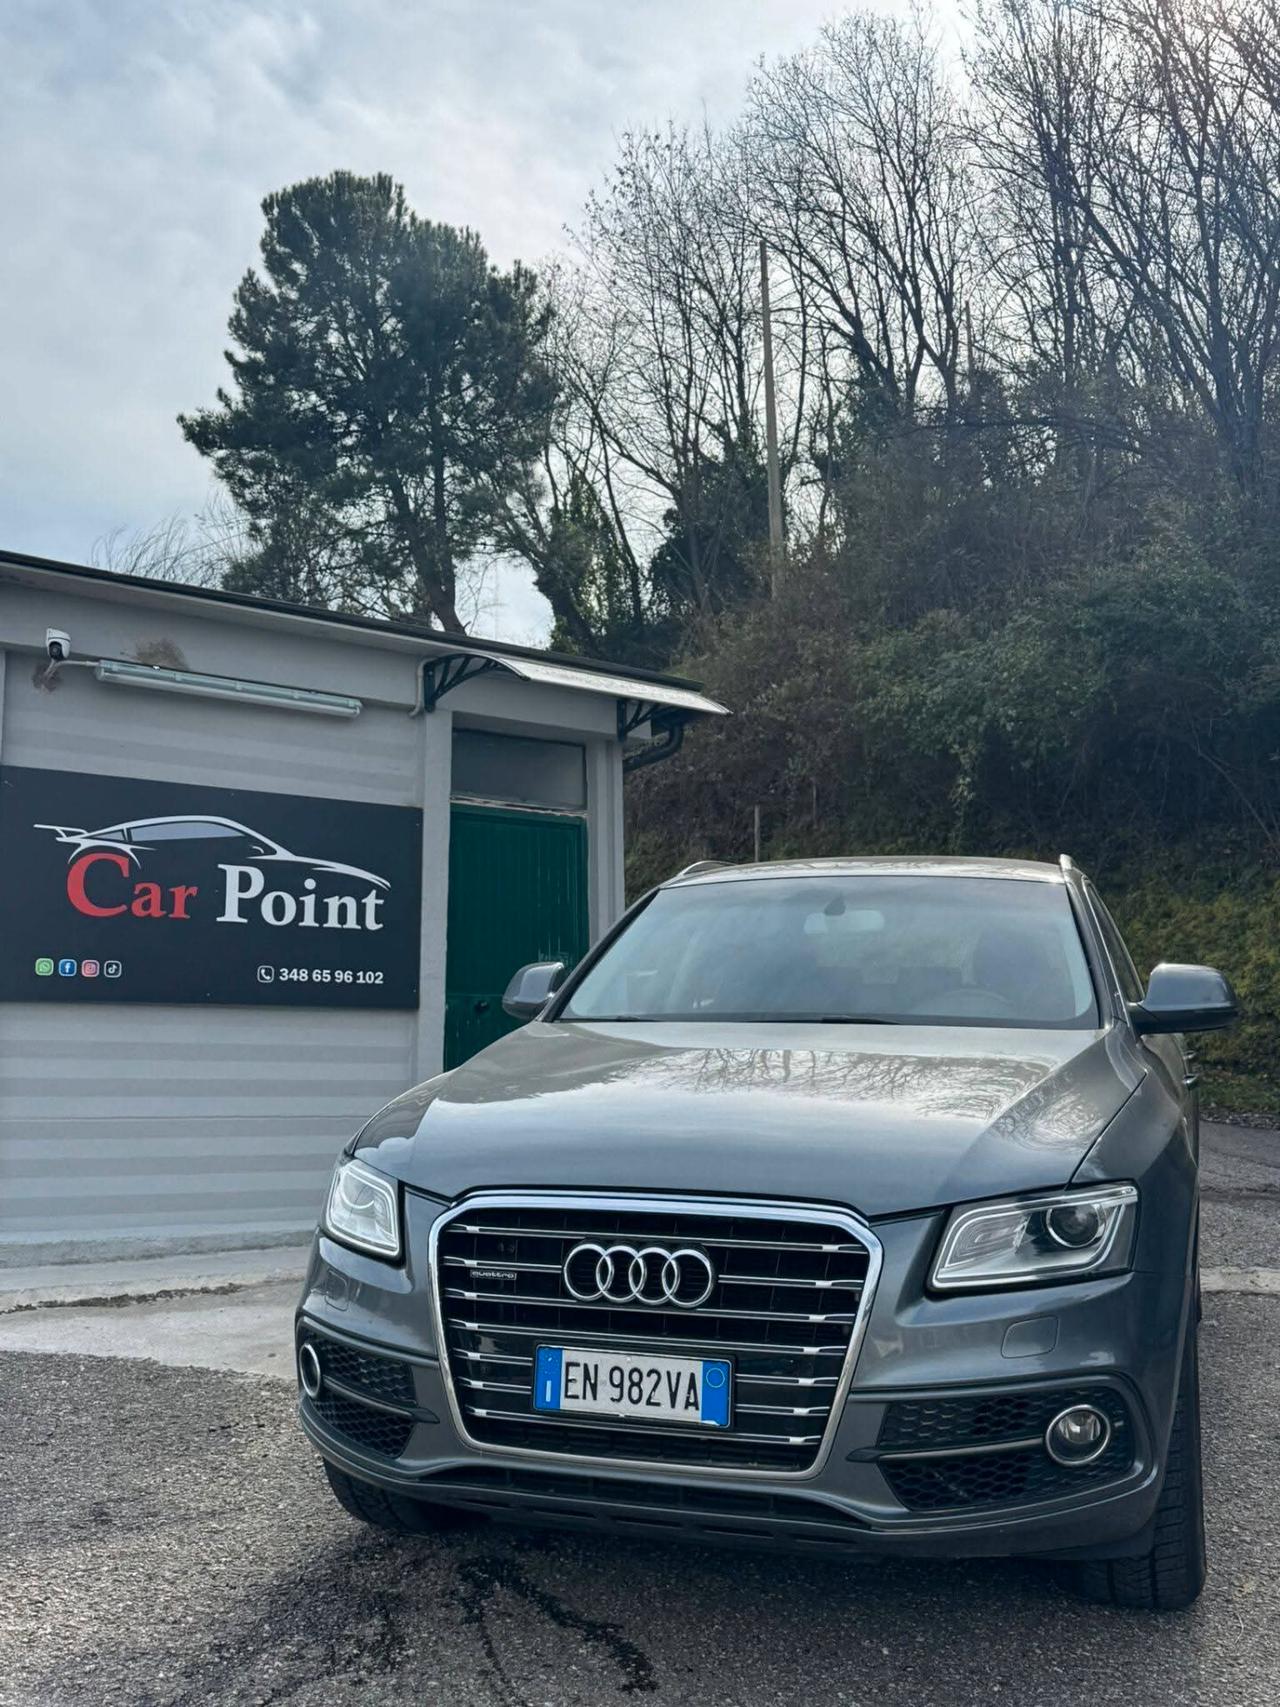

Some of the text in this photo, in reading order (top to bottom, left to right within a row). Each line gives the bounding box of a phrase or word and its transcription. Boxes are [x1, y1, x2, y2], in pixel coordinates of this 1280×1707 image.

[66, 852, 384, 930] Car Point
[279, 968, 384, 984] 348 65 96 102
[472, 1271, 514, 1279] quattro
[564, 1361, 700, 1411] EN 982VA
